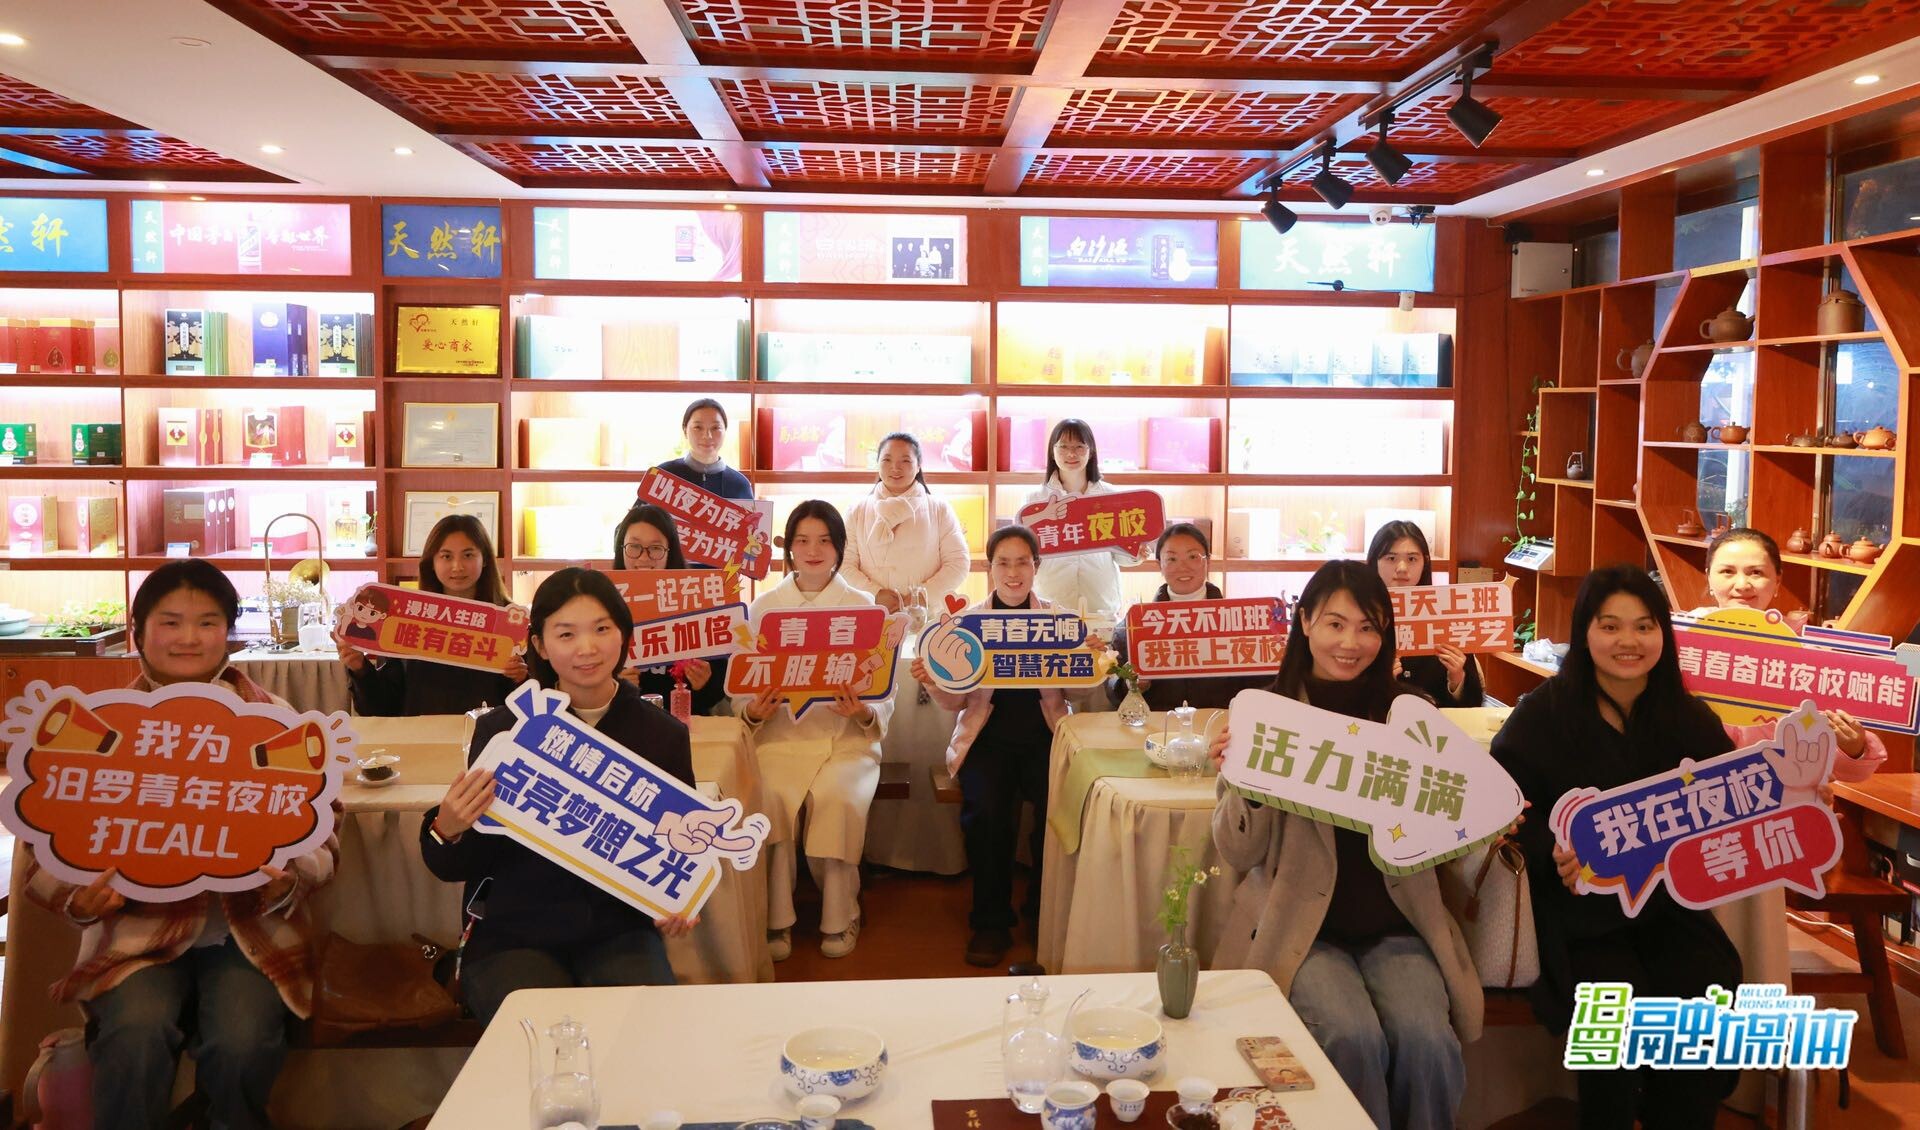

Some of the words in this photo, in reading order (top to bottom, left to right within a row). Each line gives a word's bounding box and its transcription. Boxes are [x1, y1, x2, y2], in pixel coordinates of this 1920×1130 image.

[387, 216, 501, 264] 天然轩
[1272, 237, 1400, 280] 天然轩
[648, 473, 746, 532] 以夜为序
[1037, 508, 1147, 549] 青年夜校
[404, 600, 488, 629] 漫漫人生路
[1141, 604, 1271, 635] 今天不加班
[1388, 587, 1500, 617] 白天上班
[393, 622, 498, 662] 唯有奋斗
[779, 616, 857, 647] 青春
[980, 618, 1080, 643] 青春无悔
[1144, 635, 1287, 668] 我来上夜校
[1394, 620, 1507, 650] 晚上学艺
[740, 652, 858, 688] 不服输
[991, 653, 1094, 678] 智慧充盈
[1678, 646, 1907, 707] 青春奋进夜校赋能
[135, 719, 231, 763] 我为
[537, 724, 662, 813] 燃情启航
[1246, 722, 1468, 822] 活力满满
[42, 765, 310, 816] 汨罗青年夜校
[1592, 762, 1782, 858] 我在夜校
[88, 816, 239, 859] 打CALL
[494, 757, 698, 900] 点亮梦想之光
[1700, 816, 1805, 882] 等你
